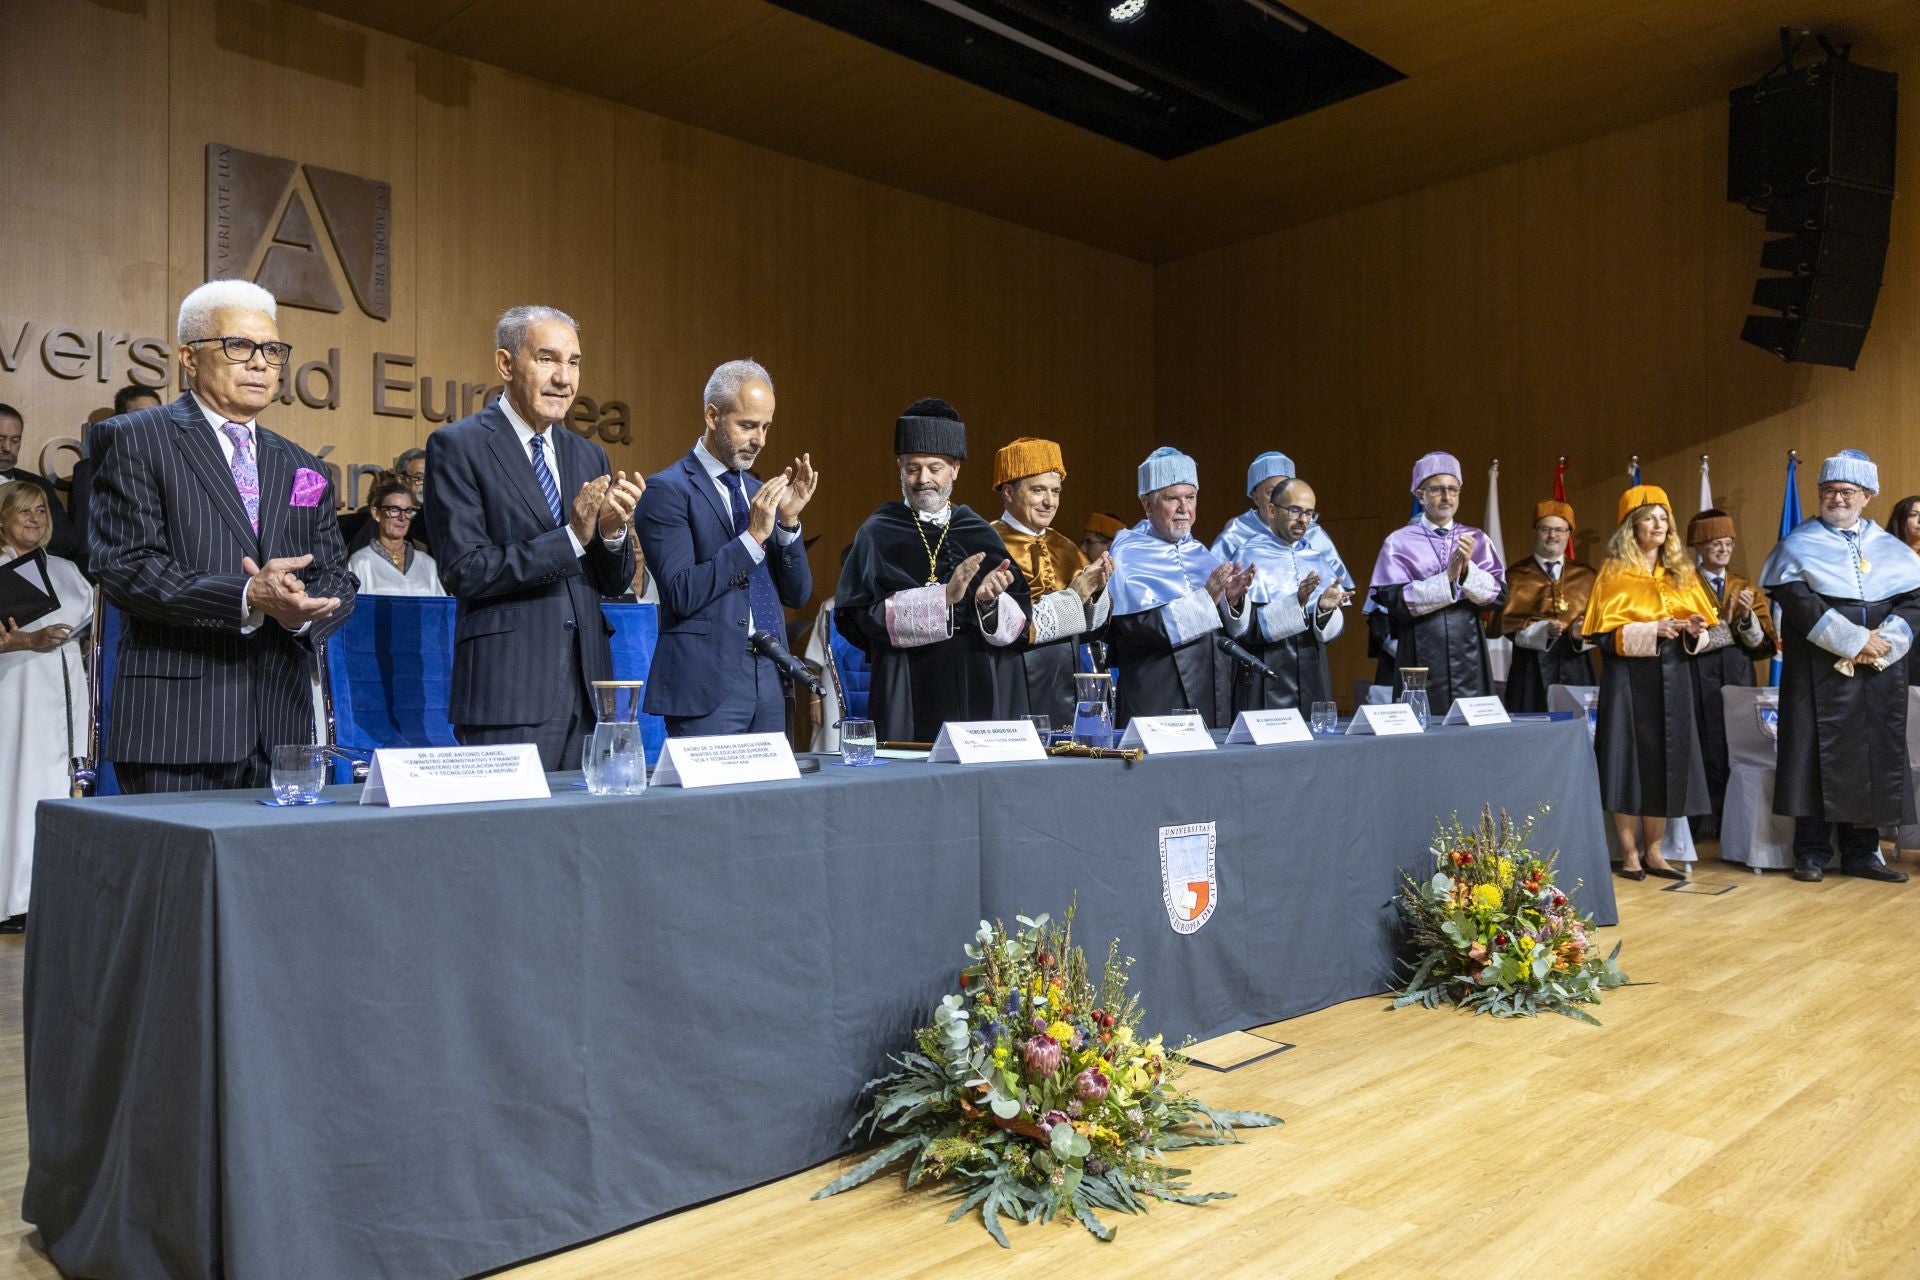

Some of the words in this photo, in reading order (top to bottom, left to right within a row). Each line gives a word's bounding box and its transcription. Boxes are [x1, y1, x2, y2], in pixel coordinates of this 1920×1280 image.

[218, 148, 232, 179] LUX
[218, 184, 231, 260] VERITATE
[375, 206, 387, 257] LABORE
[373, 262, 386, 314] VIRTUS
[373, 351, 633, 445] Eurea
[1165, 825, 1210, 835] UNIVERSITAS
[1173, 921, 1200, 932] EUROPEA
